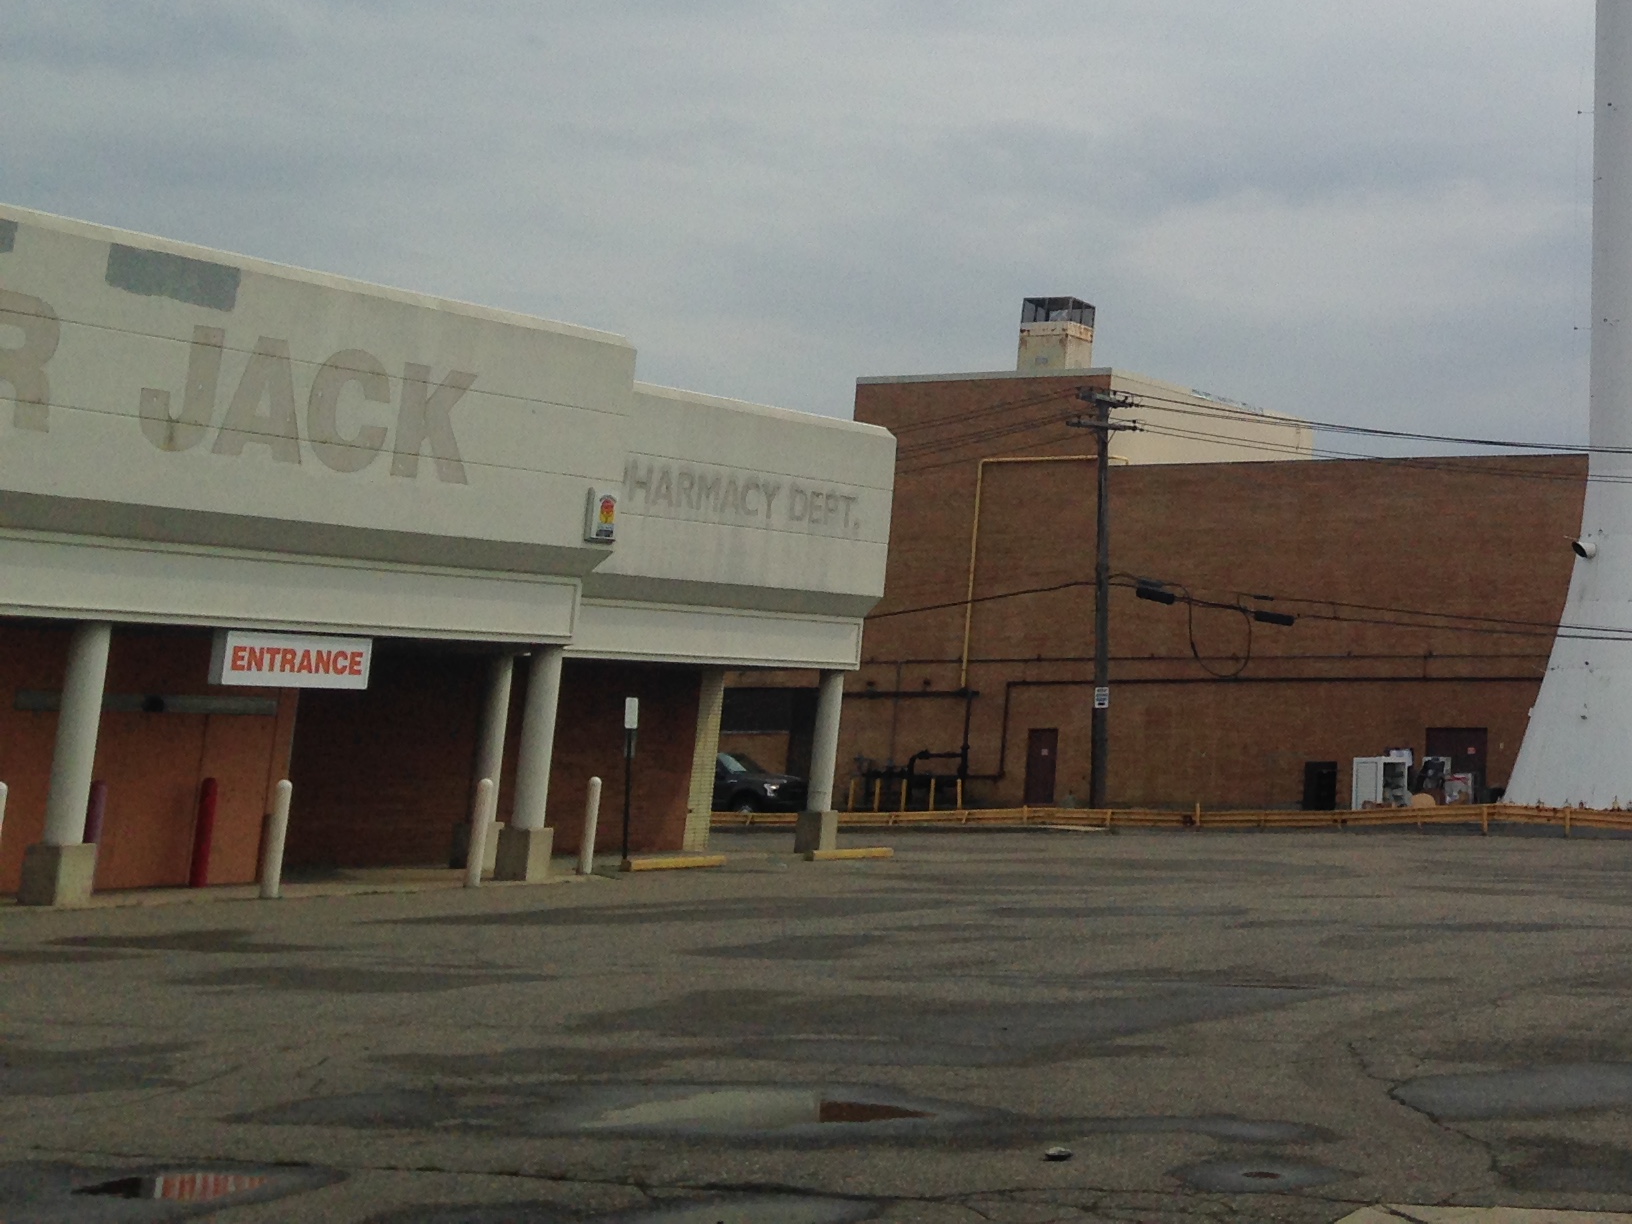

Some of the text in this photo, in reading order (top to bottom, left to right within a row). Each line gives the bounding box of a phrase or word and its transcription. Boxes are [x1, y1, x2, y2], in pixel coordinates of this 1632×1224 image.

[139, 324, 478, 485] JACK
[788, 481, 860, 531] DEPT.
[231, 645, 364, 676] ENTRANCE
